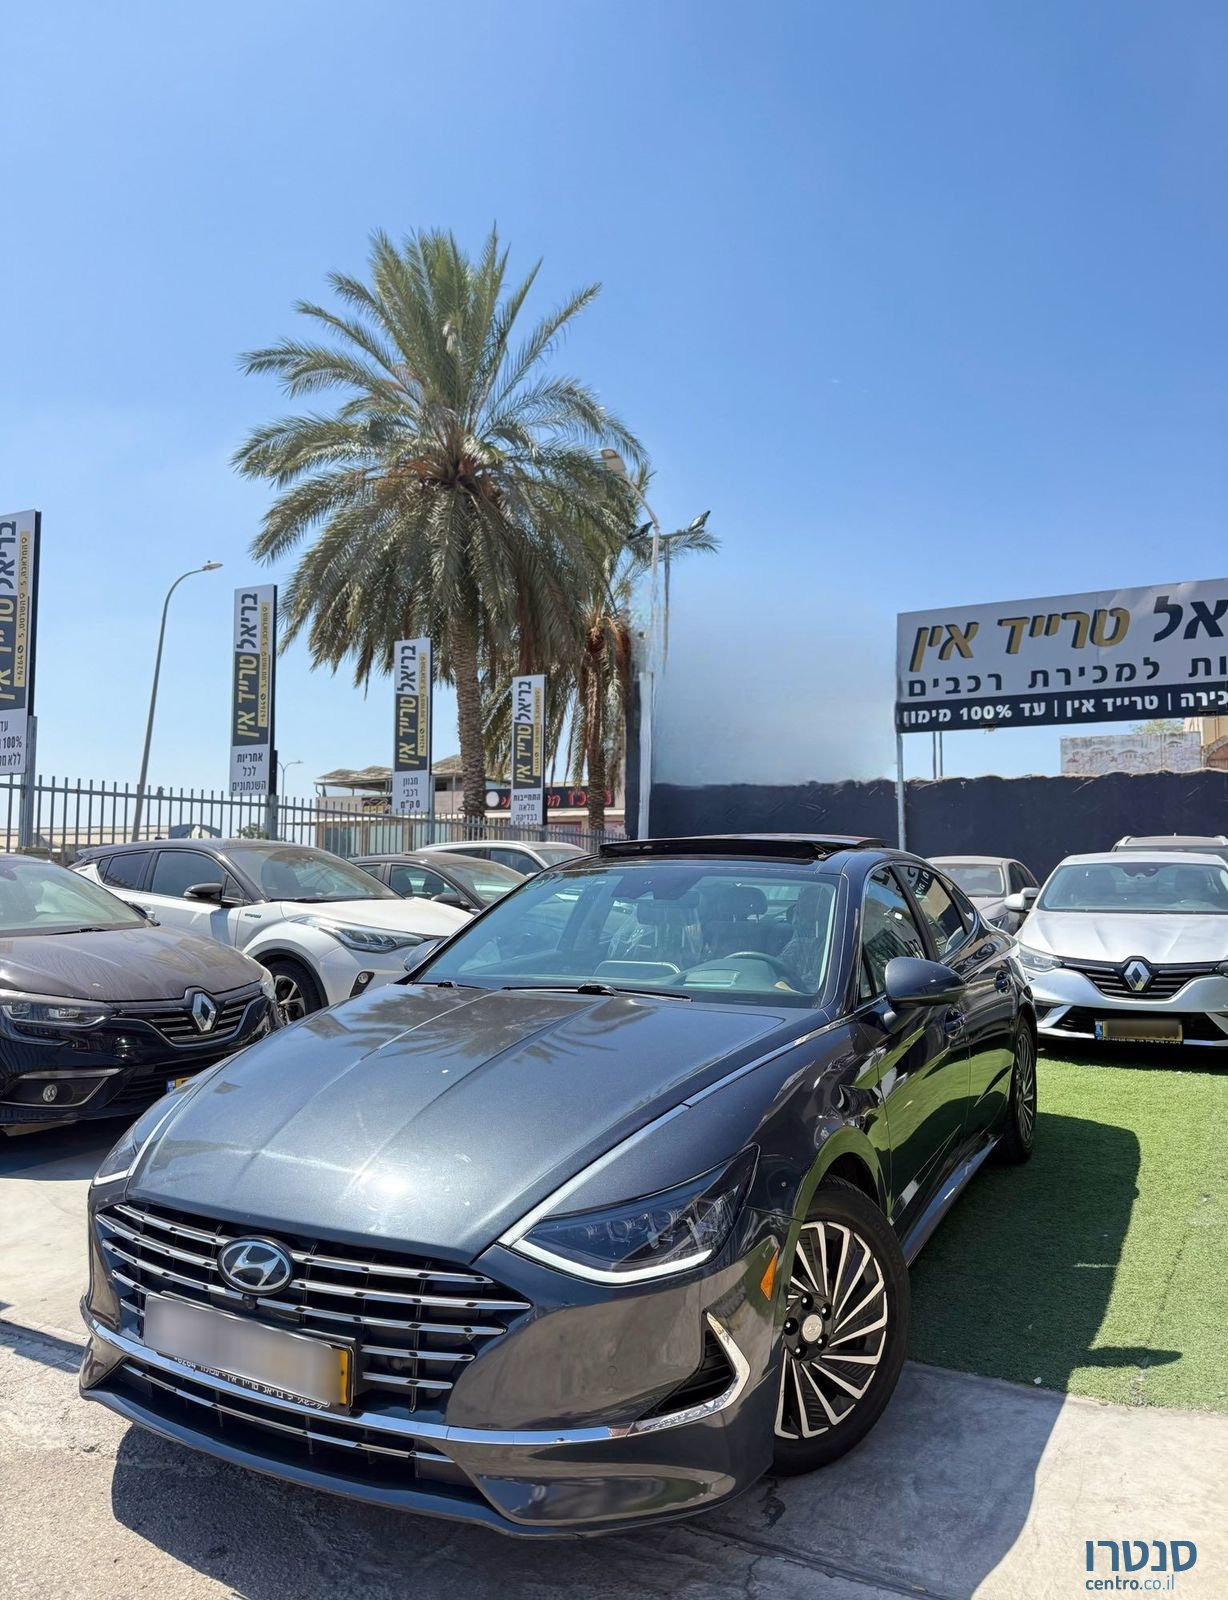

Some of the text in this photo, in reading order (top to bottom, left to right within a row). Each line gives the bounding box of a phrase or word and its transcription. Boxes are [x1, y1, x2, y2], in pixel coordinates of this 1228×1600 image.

[998, 607, 1130, 655] טרייד
[908, 622, 979, 672] אין
[236, 593, 260, 738] בריאל טרייד אין
[1028, 657, 1160, 689] למכירת
[0, 668, 16, 700] אן
[908, 673, 1003, 698] רכבים
[397, 645, 420, 765] בריאל טרייד אין
[959, 704, 1012, 721] 100%
[1019, 702, 1046, 717] עד
[1066, 699, 1096, 717] אין
[1102, 695, 1159, 712] טרייד
[903, 708, 951, 727] מימון
[515, 680, 535, 784] בריאל טרייד אין
[3, 735, 22, 749] 100%
[8, 752, 21, 766] ללא
[237, 752, 263, 763] אחריות
[242, 765, 256, 777] לכל
[232, 781, 266, 791] השנתונים
